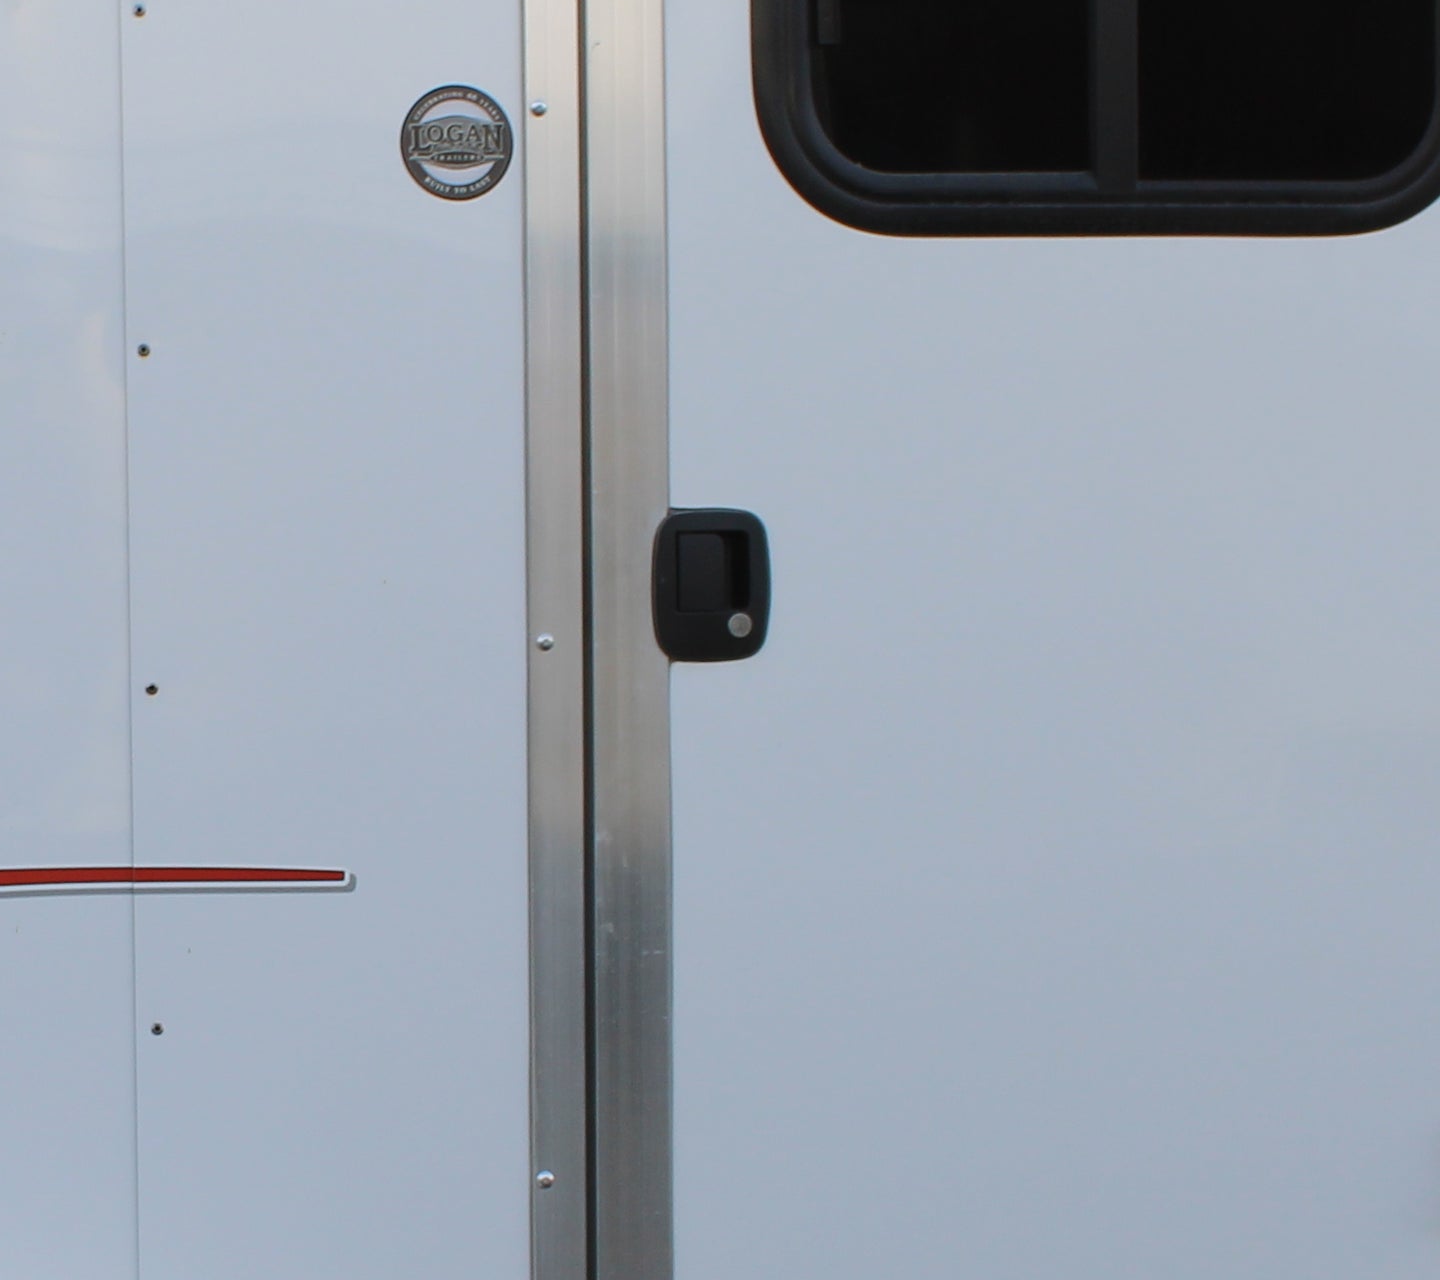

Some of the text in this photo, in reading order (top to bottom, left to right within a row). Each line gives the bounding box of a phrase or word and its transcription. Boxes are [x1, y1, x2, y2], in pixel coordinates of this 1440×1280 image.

[410, 124, 503, 152] LOGAN
[424, 176, 450, 193] BUILT
[470, 176, 491, 192] LAST
